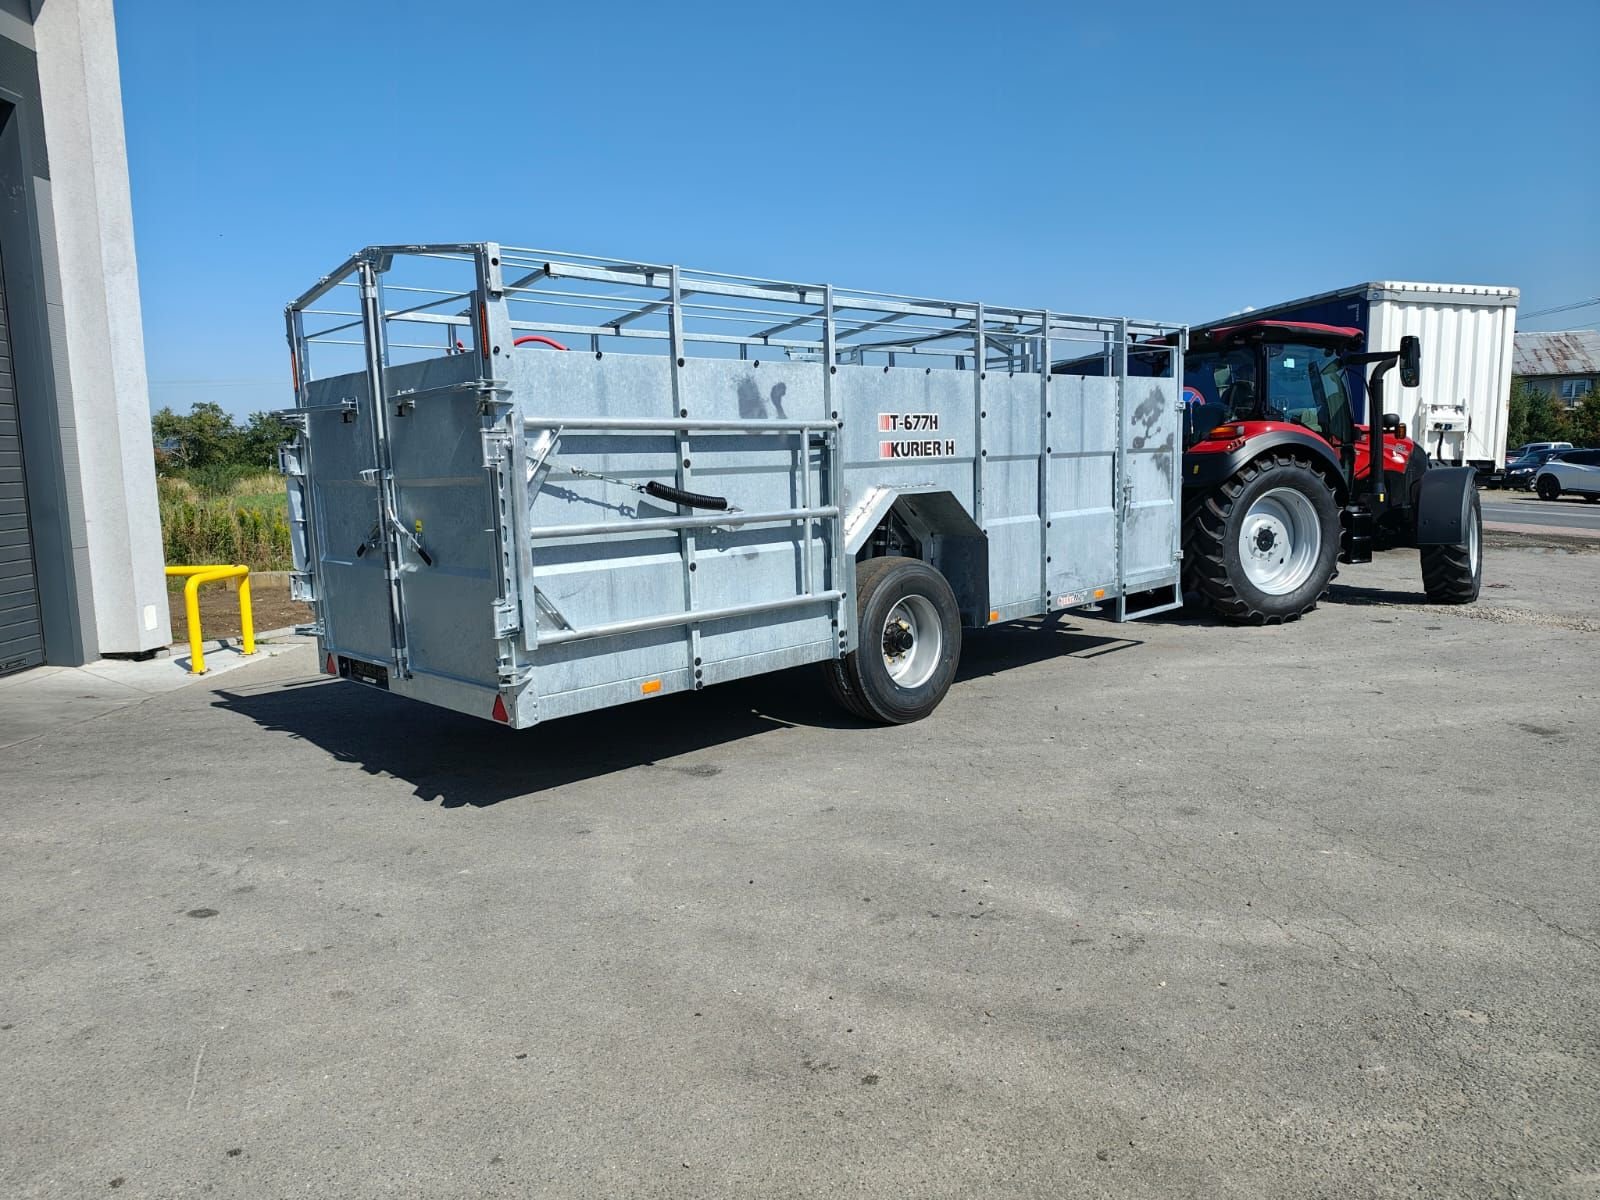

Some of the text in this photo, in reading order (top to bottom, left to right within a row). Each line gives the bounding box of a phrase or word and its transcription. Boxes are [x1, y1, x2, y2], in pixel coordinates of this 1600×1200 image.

[890, 415, 938, 430] T-677H
[891, 440, 954, 457] KURIER H
